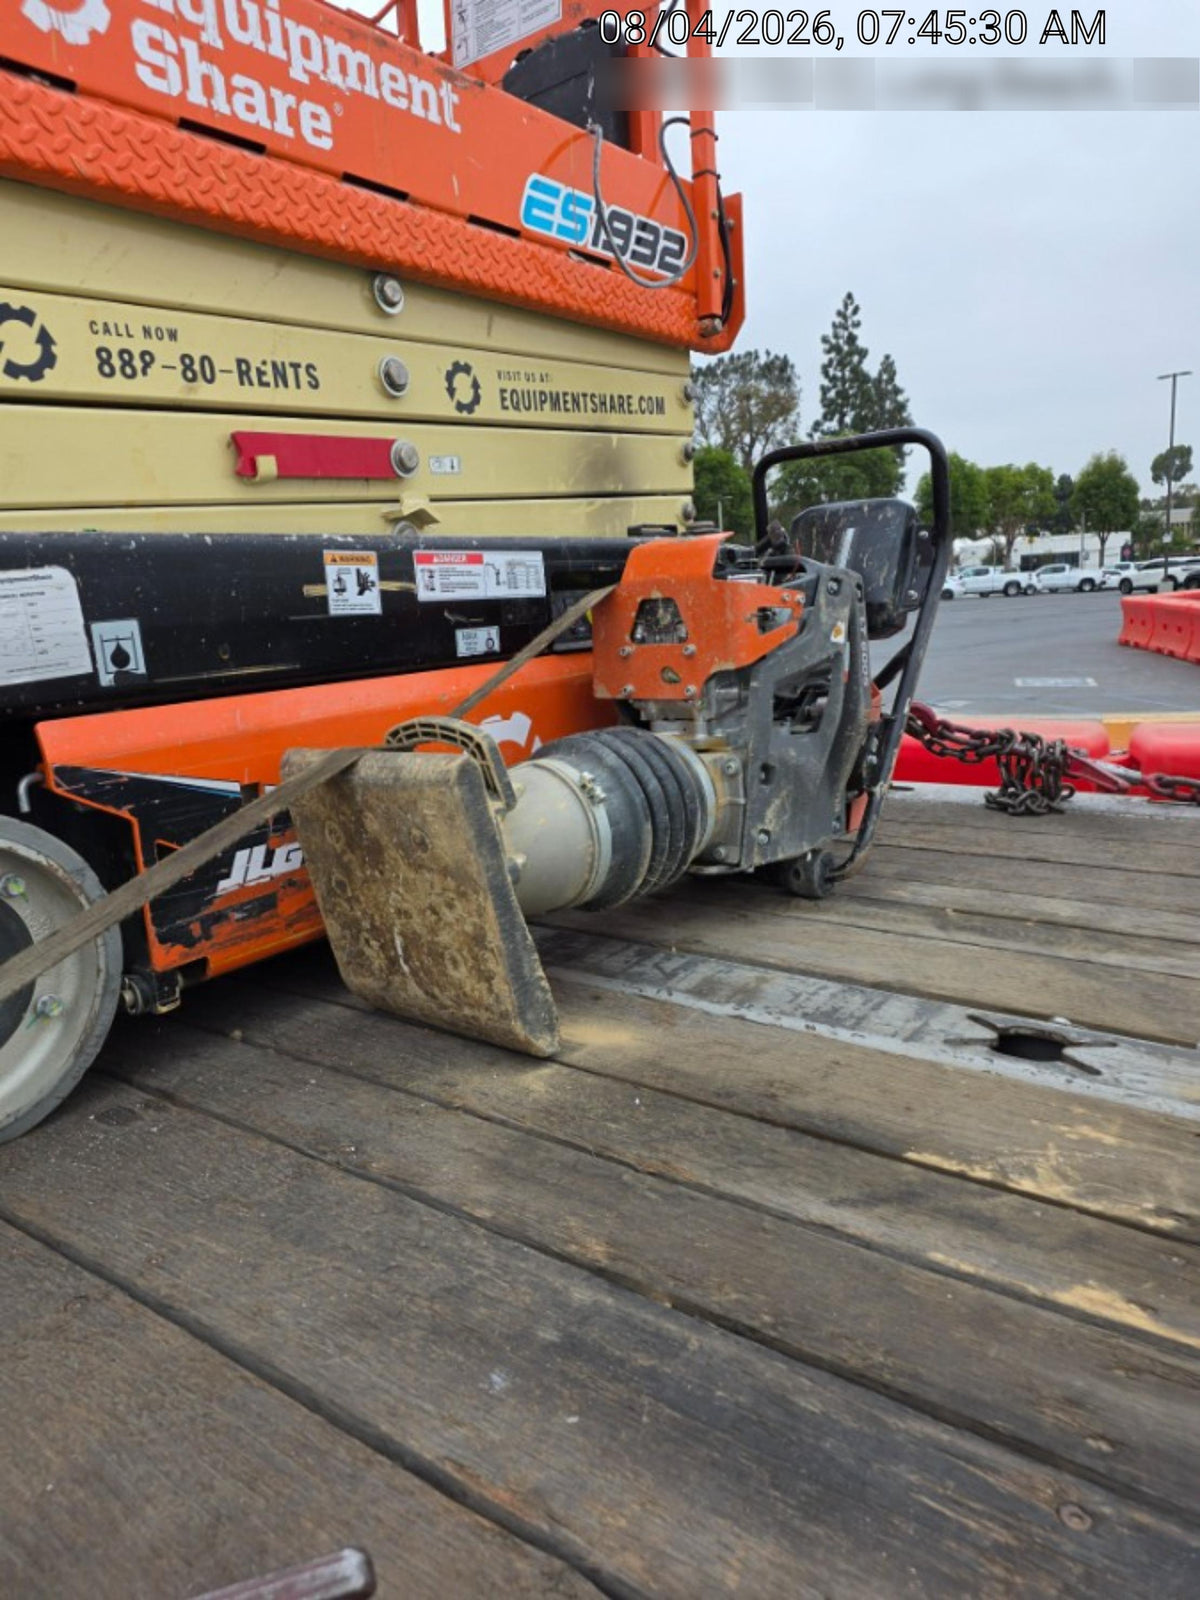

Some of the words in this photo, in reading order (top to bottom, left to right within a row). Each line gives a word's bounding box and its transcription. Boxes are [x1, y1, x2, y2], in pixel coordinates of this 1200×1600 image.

[131, 18, 333, 150] Share
[140, 0, 462, 133] quipment
[521, 176, 688, 277] ES1932
[89, 320, 134, 338] CALL
[142, 325, 178, 342] NOW
[499, 388, 666, 415] EQUIPMENTSHARE.COM
[216, 842, 304, 895] JLG
